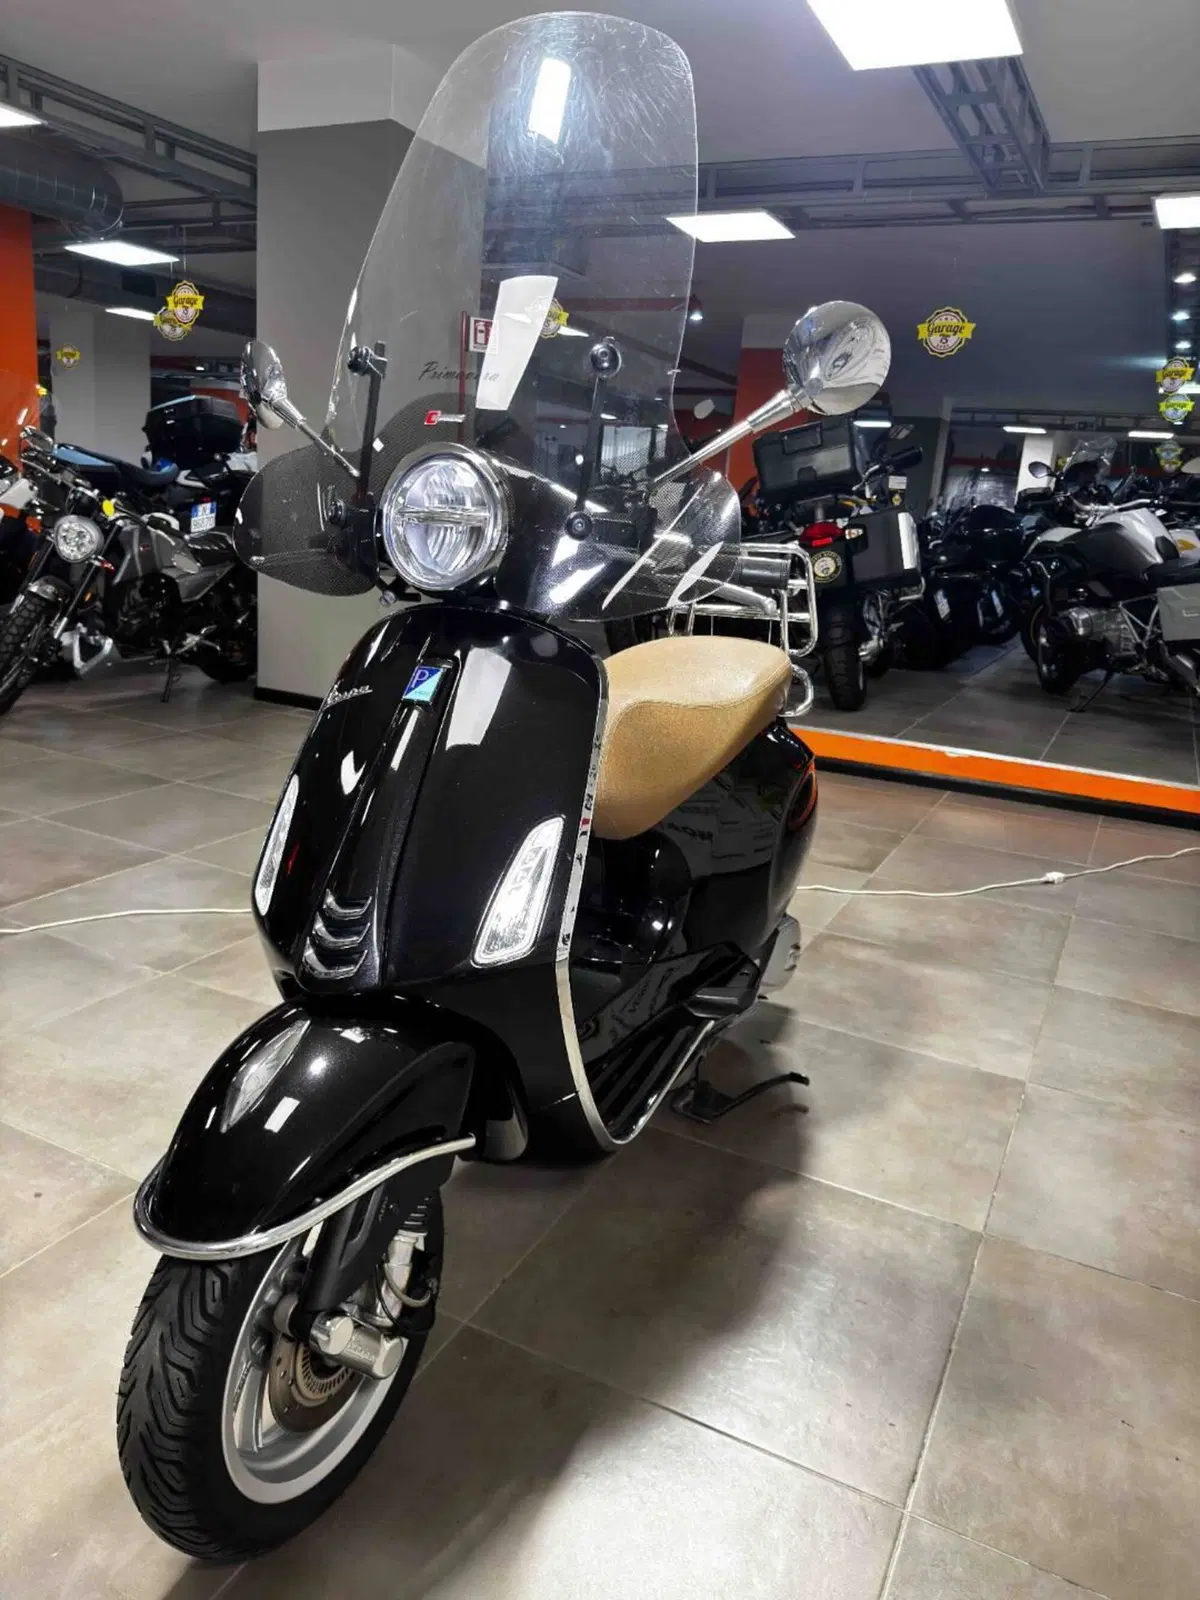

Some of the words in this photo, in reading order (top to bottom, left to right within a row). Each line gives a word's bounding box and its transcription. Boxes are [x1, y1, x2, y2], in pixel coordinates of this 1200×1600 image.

[173, 295, 198, 307] Garage
[927, 322, 965, 337] Garage
[323, 679, 373, 710] Vespa
